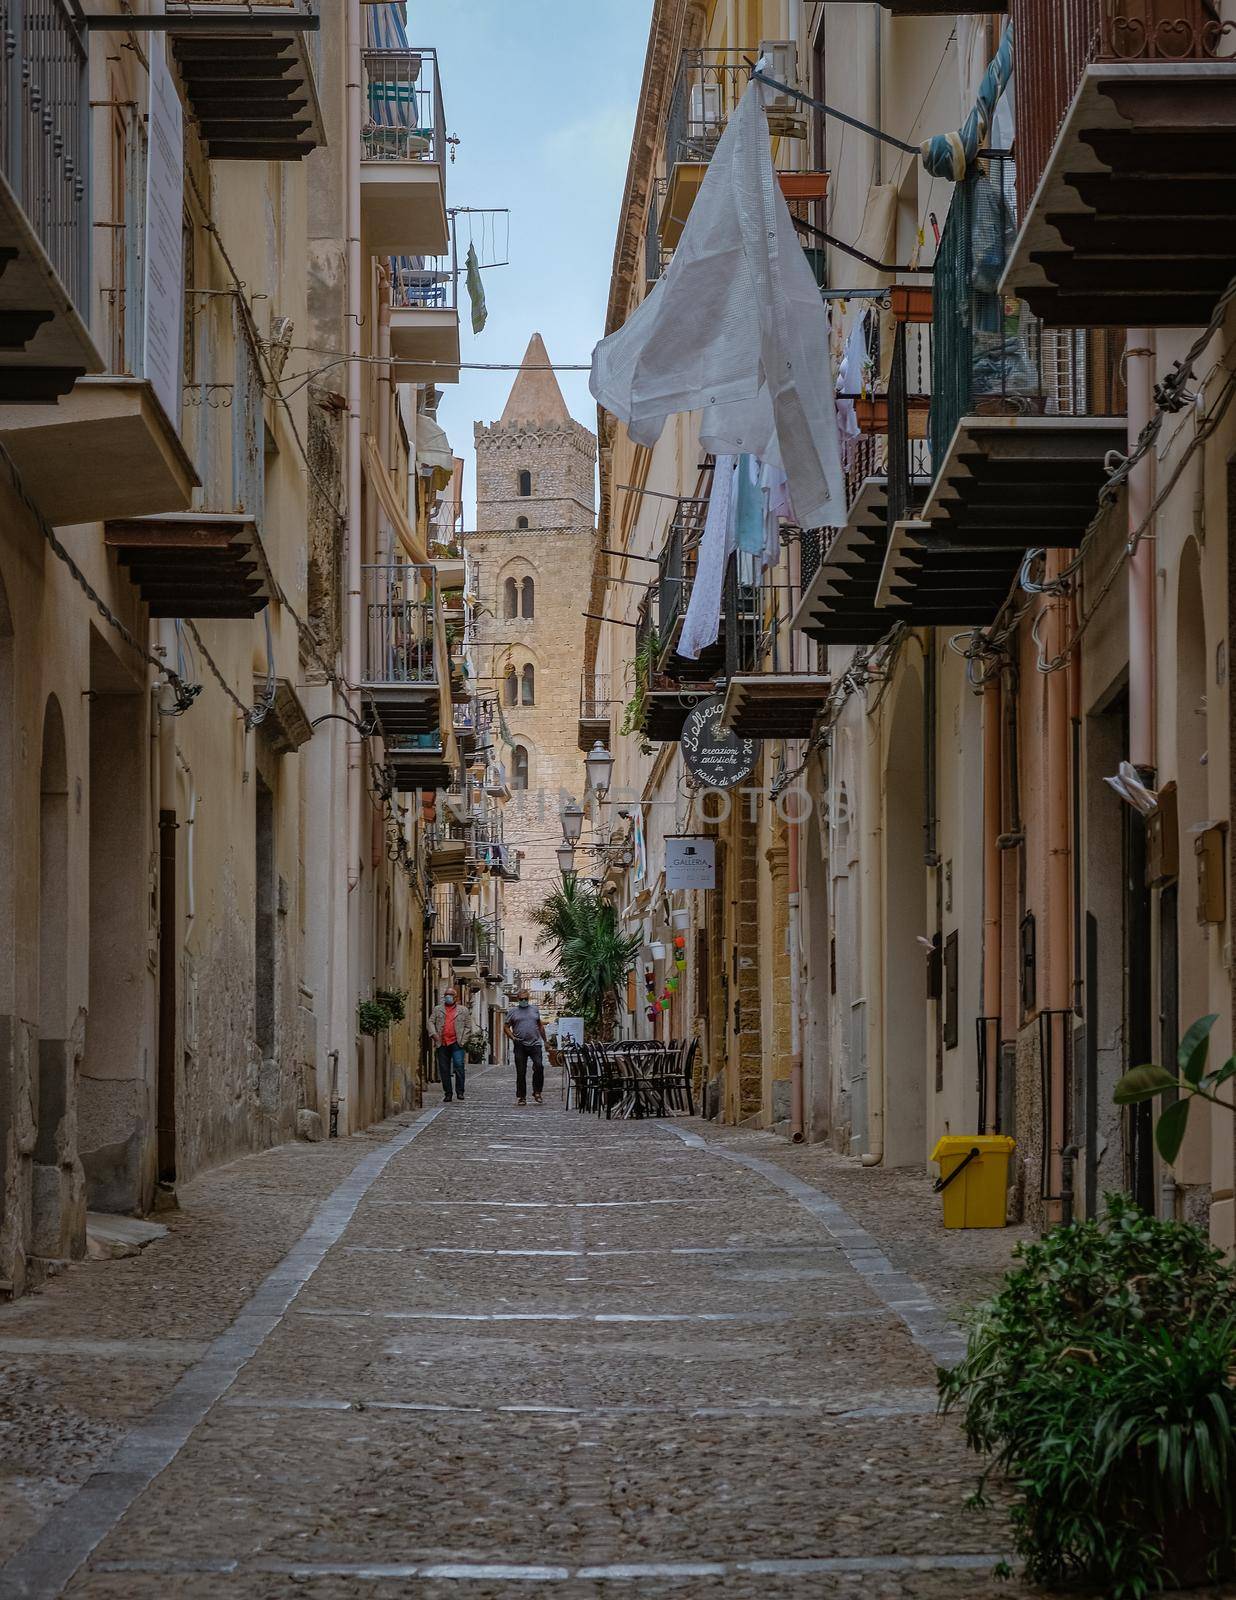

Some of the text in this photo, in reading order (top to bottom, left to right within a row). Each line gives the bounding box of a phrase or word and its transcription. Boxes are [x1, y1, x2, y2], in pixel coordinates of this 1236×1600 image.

[701, 747, 739, 755] creazioni
[742, 738, 753, 755] ose
[700, 755, 738, 764] artistiche
[693, 767, 750, 786] pasta di mais
[673, 858, 708, 866] GALLERIA
